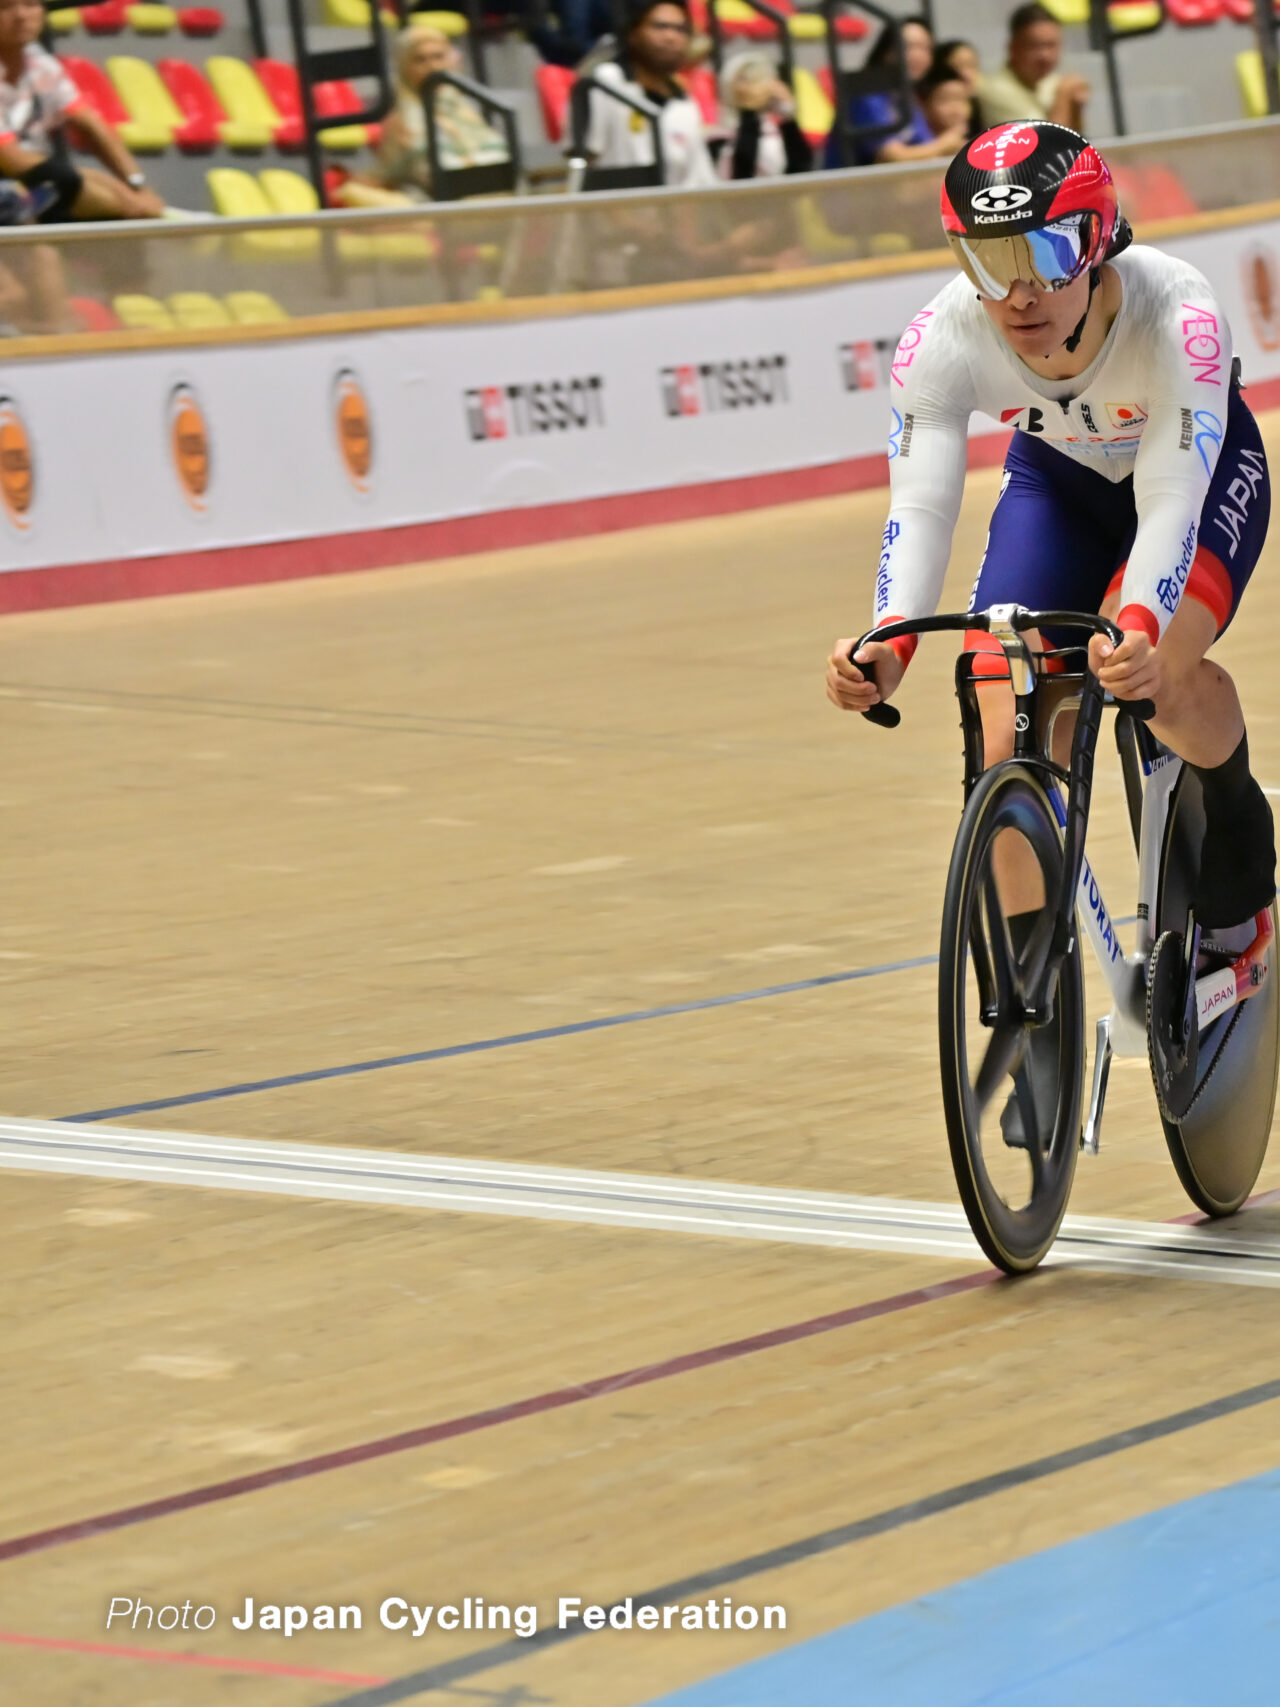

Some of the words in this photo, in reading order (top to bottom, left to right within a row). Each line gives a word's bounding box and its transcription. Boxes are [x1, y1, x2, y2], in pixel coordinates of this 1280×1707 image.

[974, 210, 1033, 225] Kabuto
[506, 374, 606, 435] TISSOT
[699, 354, 788, 408] TISSOT
[899, 413, 914, 458] KEIRIN
[1179, 408, 1193, 451] KEIRIN
[1175, 521, 1197, 584] Cyclers
[877, 552, 893, 612] Cyclers
[1201, 984, 1234, 1015] JAPAN
